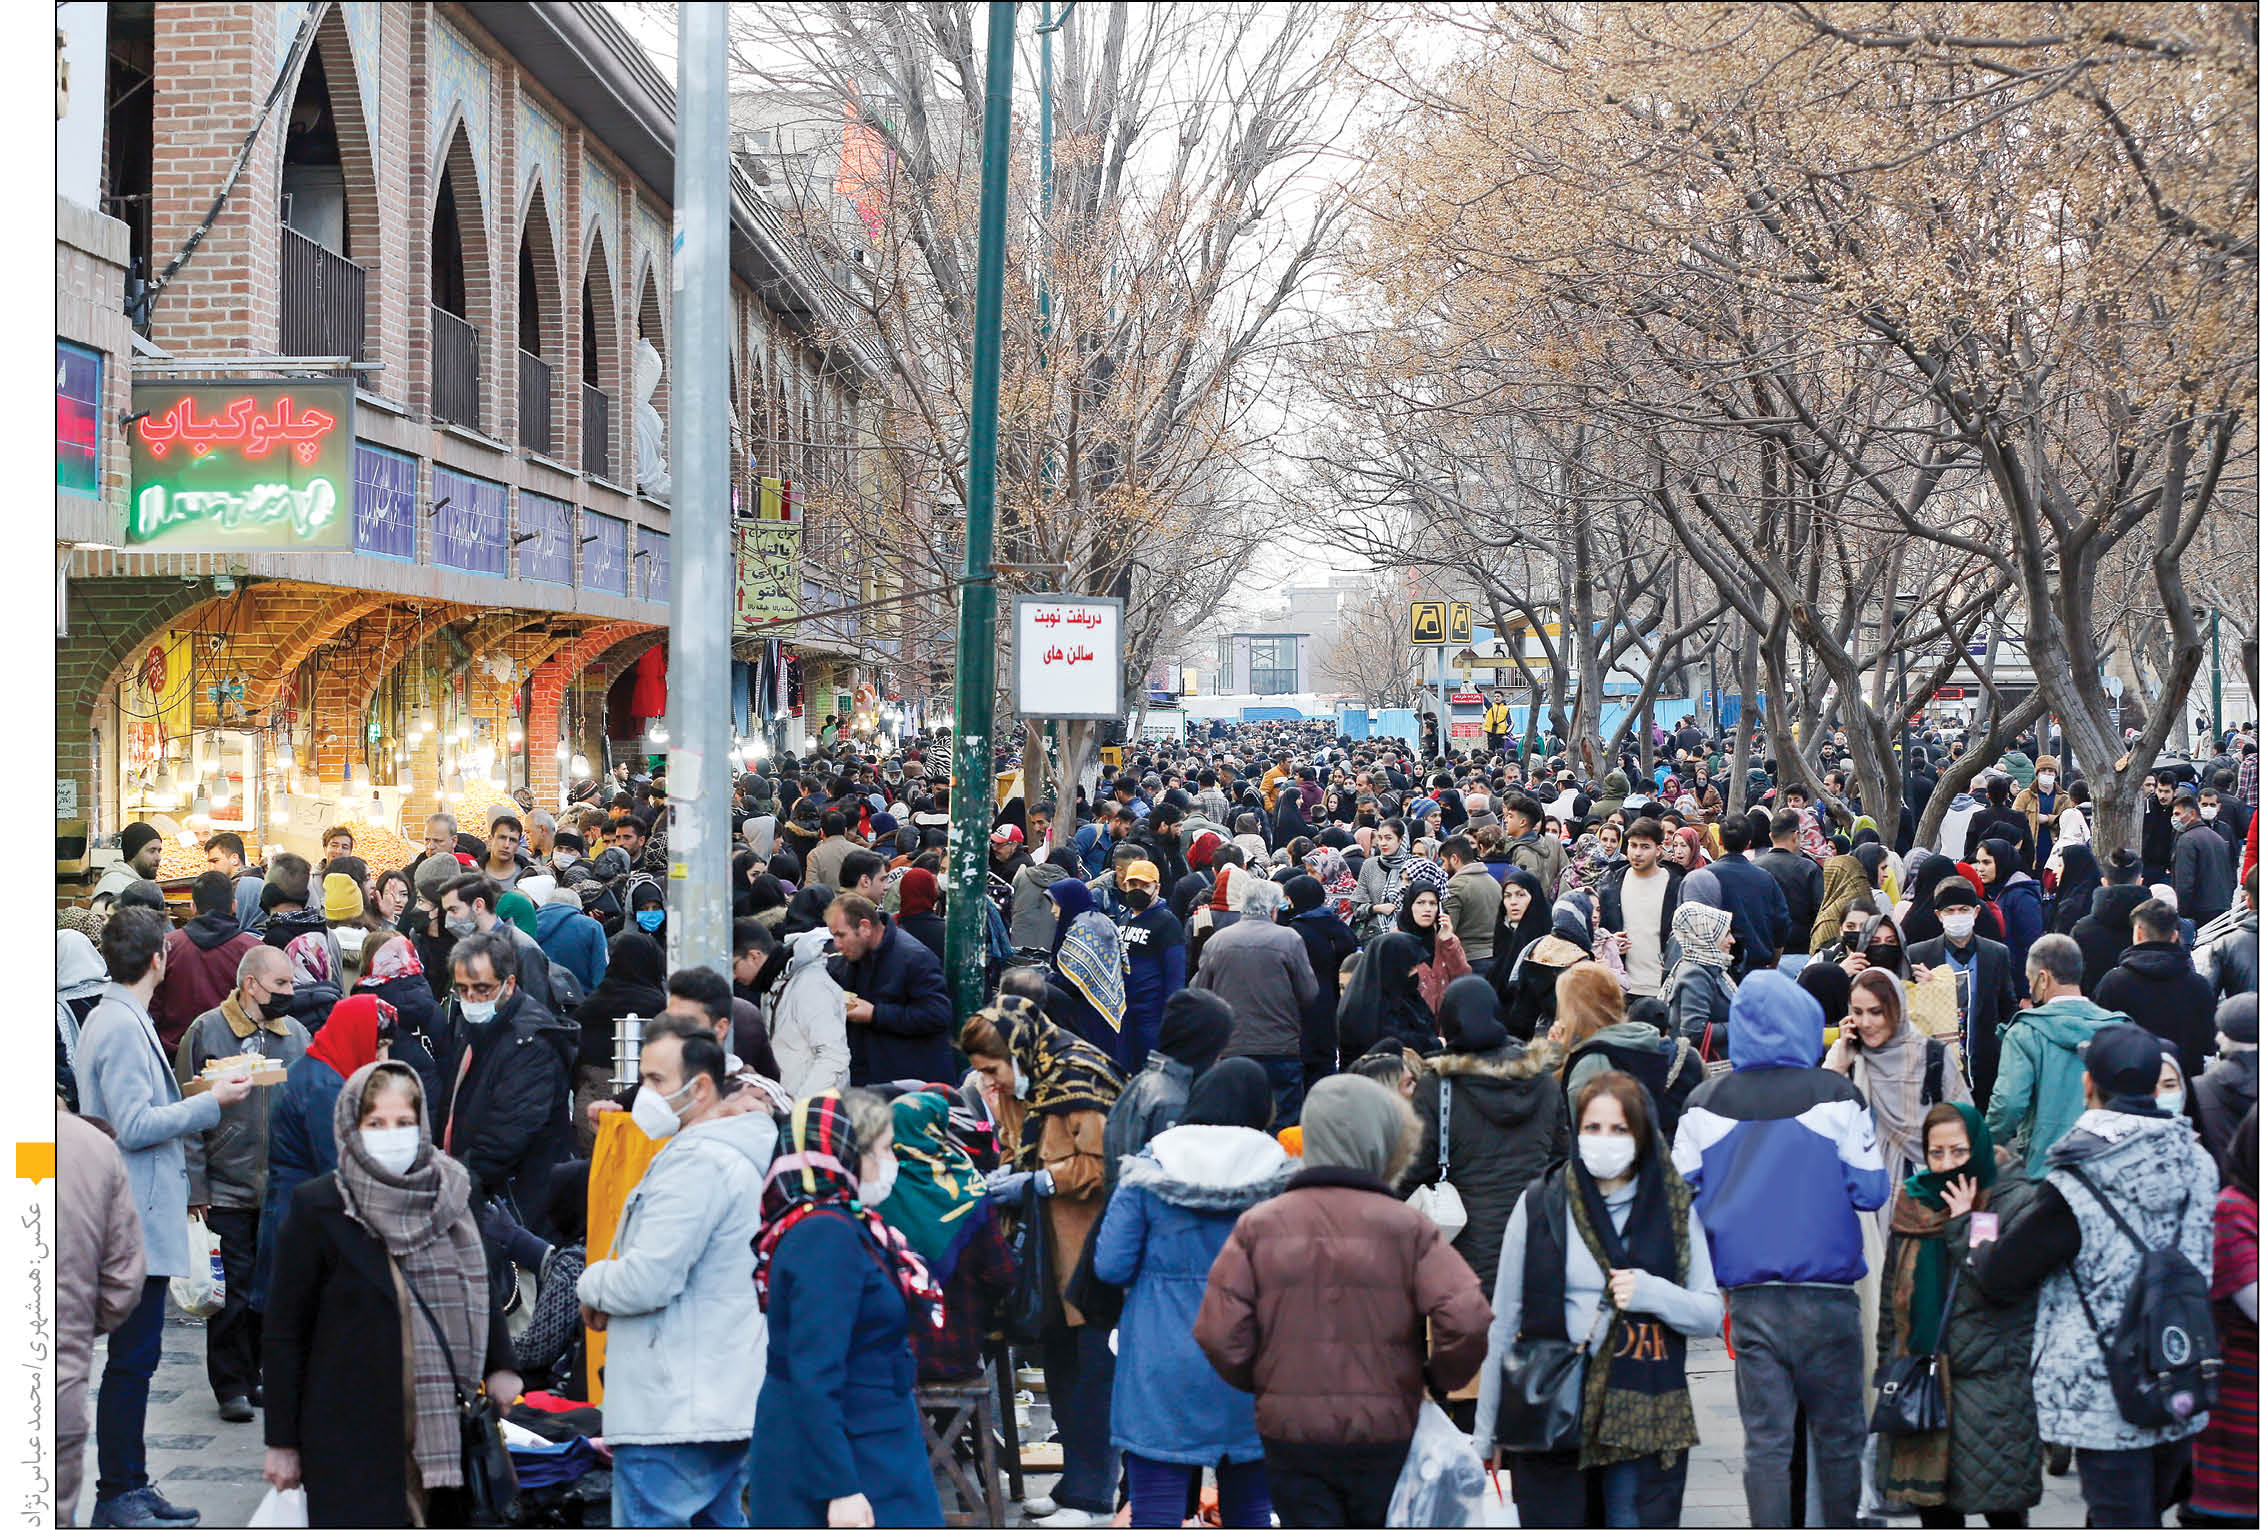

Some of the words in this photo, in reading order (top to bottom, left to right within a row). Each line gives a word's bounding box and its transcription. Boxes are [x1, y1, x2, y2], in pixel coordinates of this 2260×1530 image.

[1034, 607, 1061, 628] نوبت
[1066, 608, 1102, 629] دریافت
[1043, 645, 1064, 665] های
[1067, 645, 1094, 665] سالن
